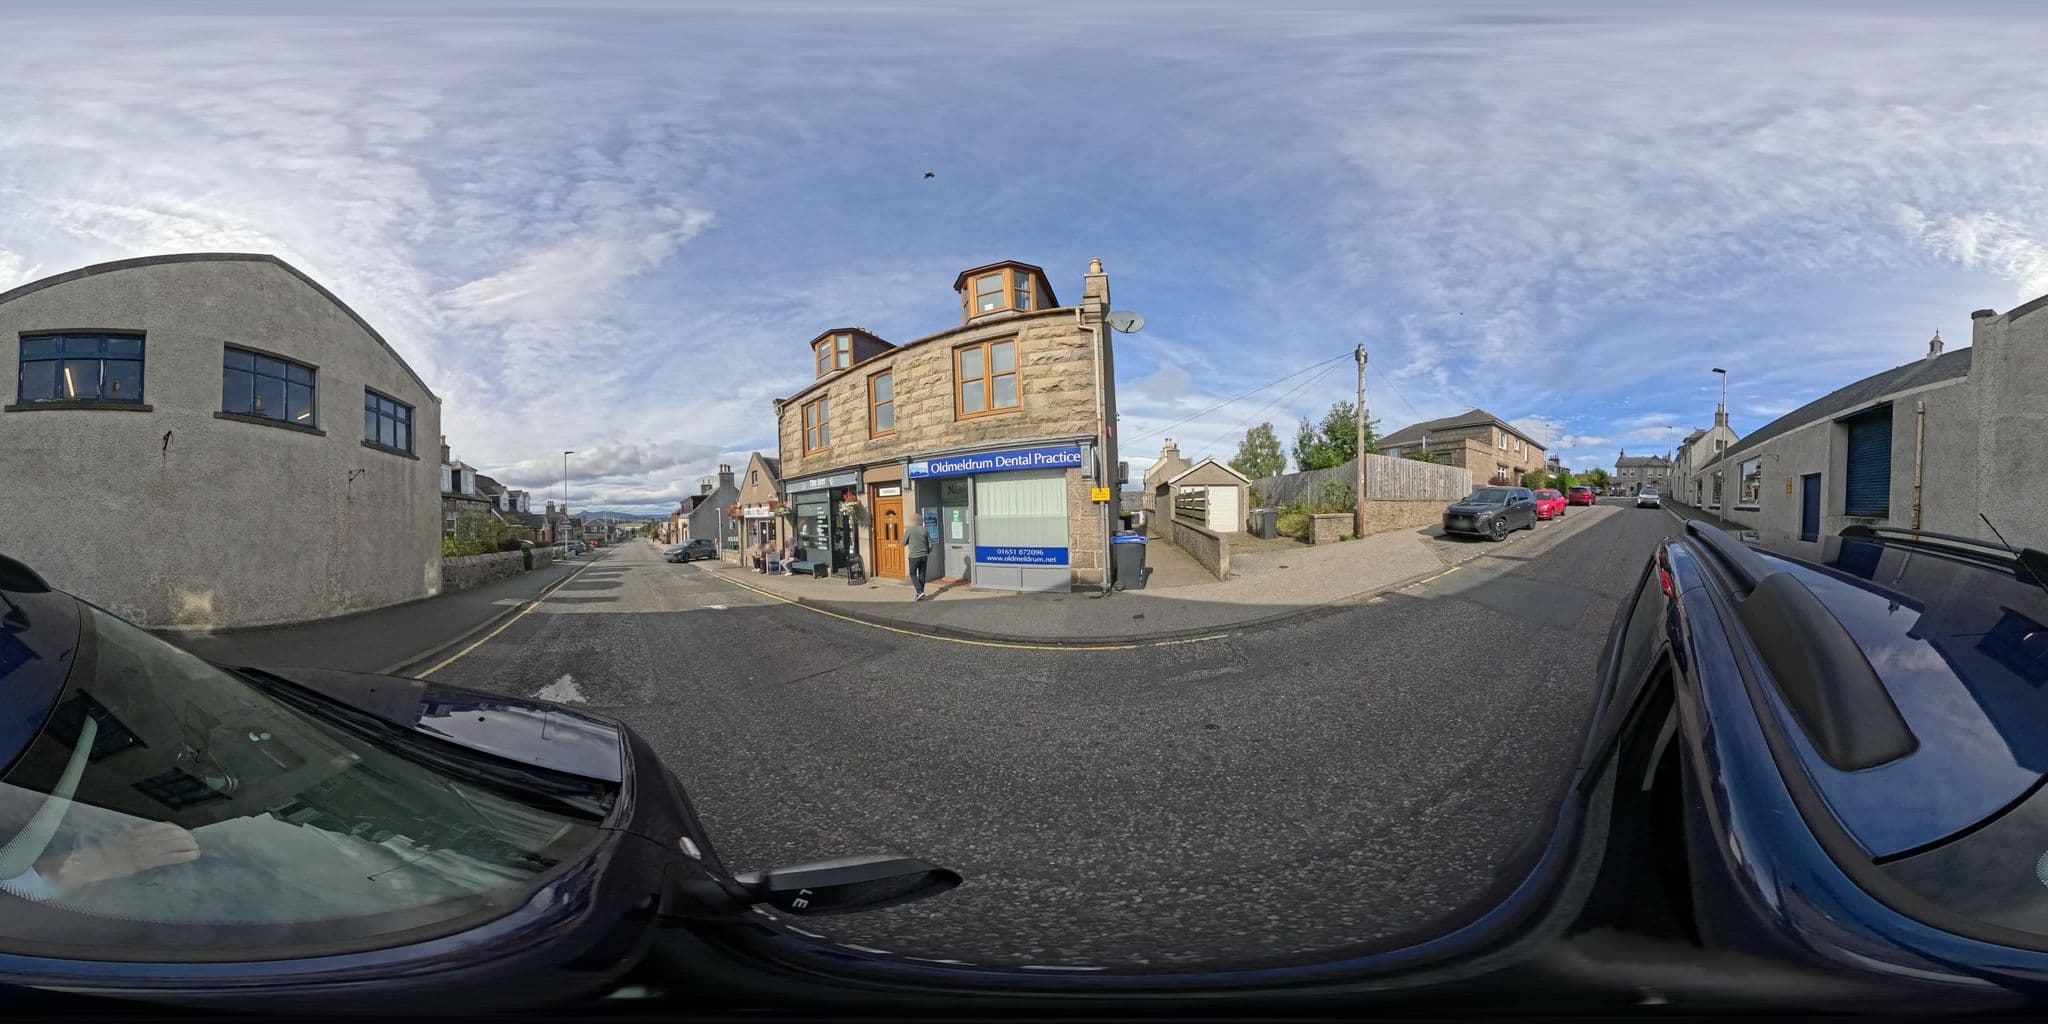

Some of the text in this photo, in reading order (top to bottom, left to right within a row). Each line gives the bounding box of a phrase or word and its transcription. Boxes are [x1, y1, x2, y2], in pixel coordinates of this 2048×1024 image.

[931, 451, 1081, 474] Oldmeldrum Dental Practice
[987, 555, 1057, 563] www.oldmeldrum.net
